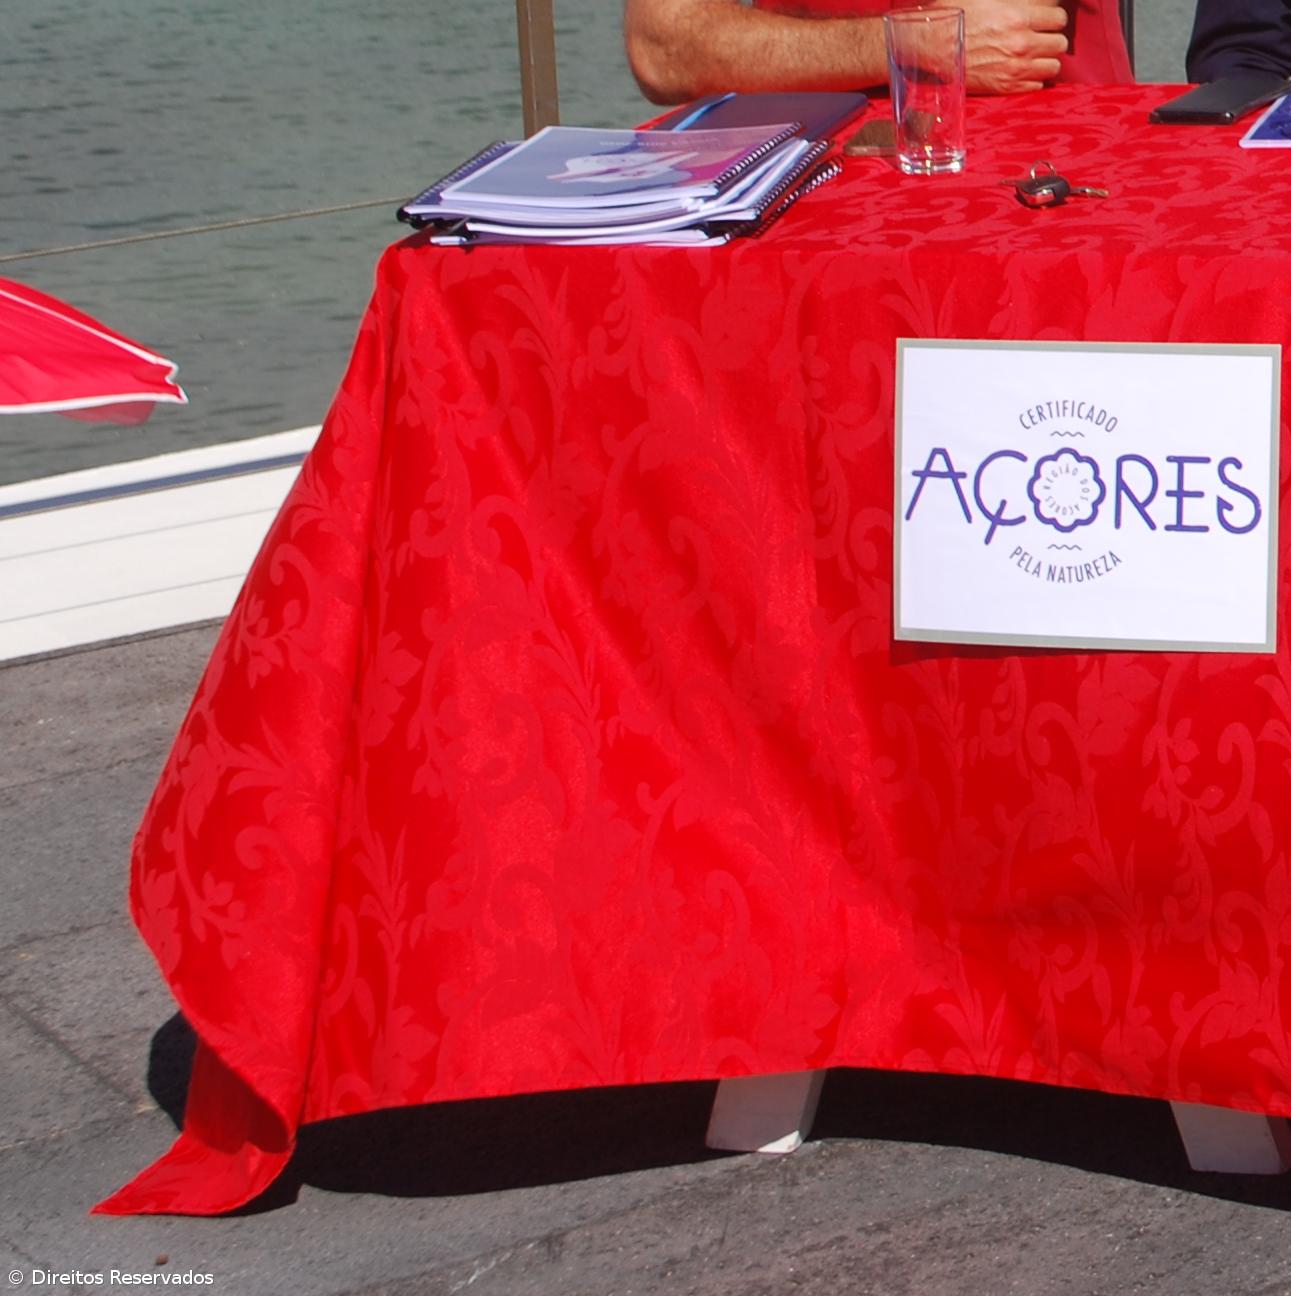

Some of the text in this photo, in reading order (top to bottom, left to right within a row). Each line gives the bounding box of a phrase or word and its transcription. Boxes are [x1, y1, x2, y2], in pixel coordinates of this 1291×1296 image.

[1019, 399, 1118, 433] CERTIFICADO
[905, 447, 1262, 545] AÇORES
[1009, 546, 1123, 584] PELA NATUREZA
